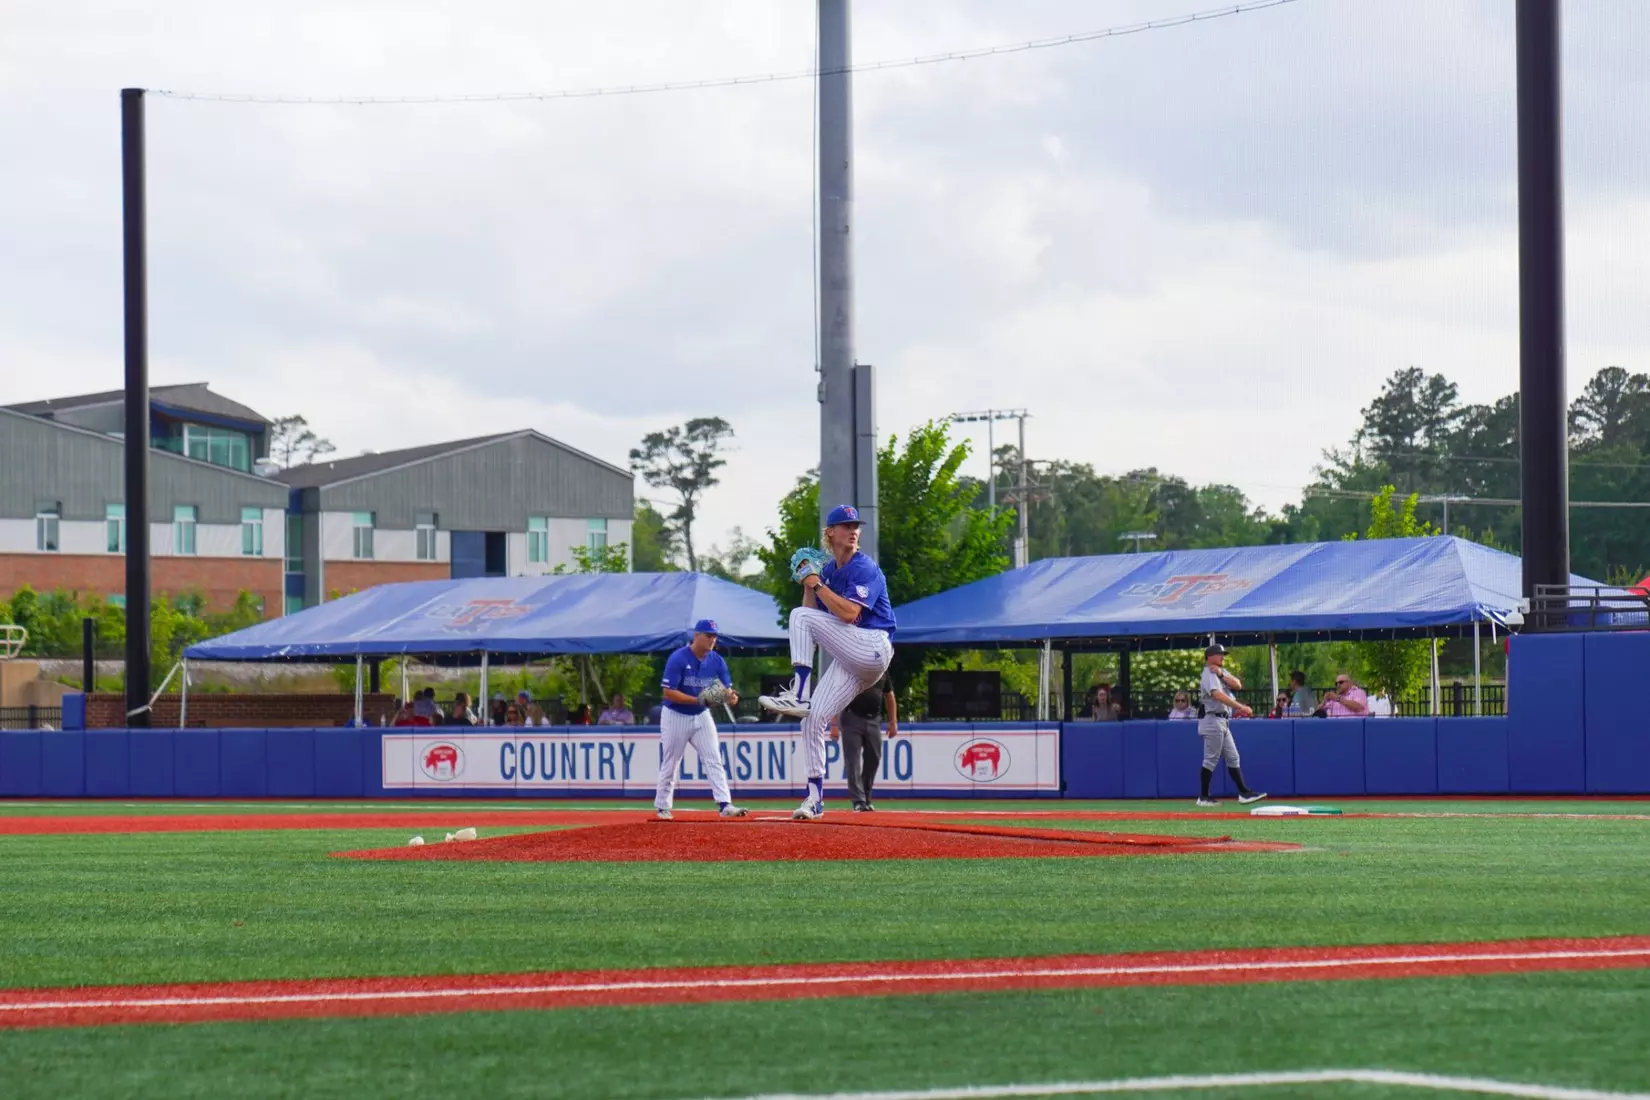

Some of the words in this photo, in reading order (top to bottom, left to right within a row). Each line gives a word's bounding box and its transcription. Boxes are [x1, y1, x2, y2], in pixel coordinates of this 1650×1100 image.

[500, 742, 635, 780] COUNTRY
[659, 740, 796, 780] LASIN'
[824, 740, 912, 780] PIO
